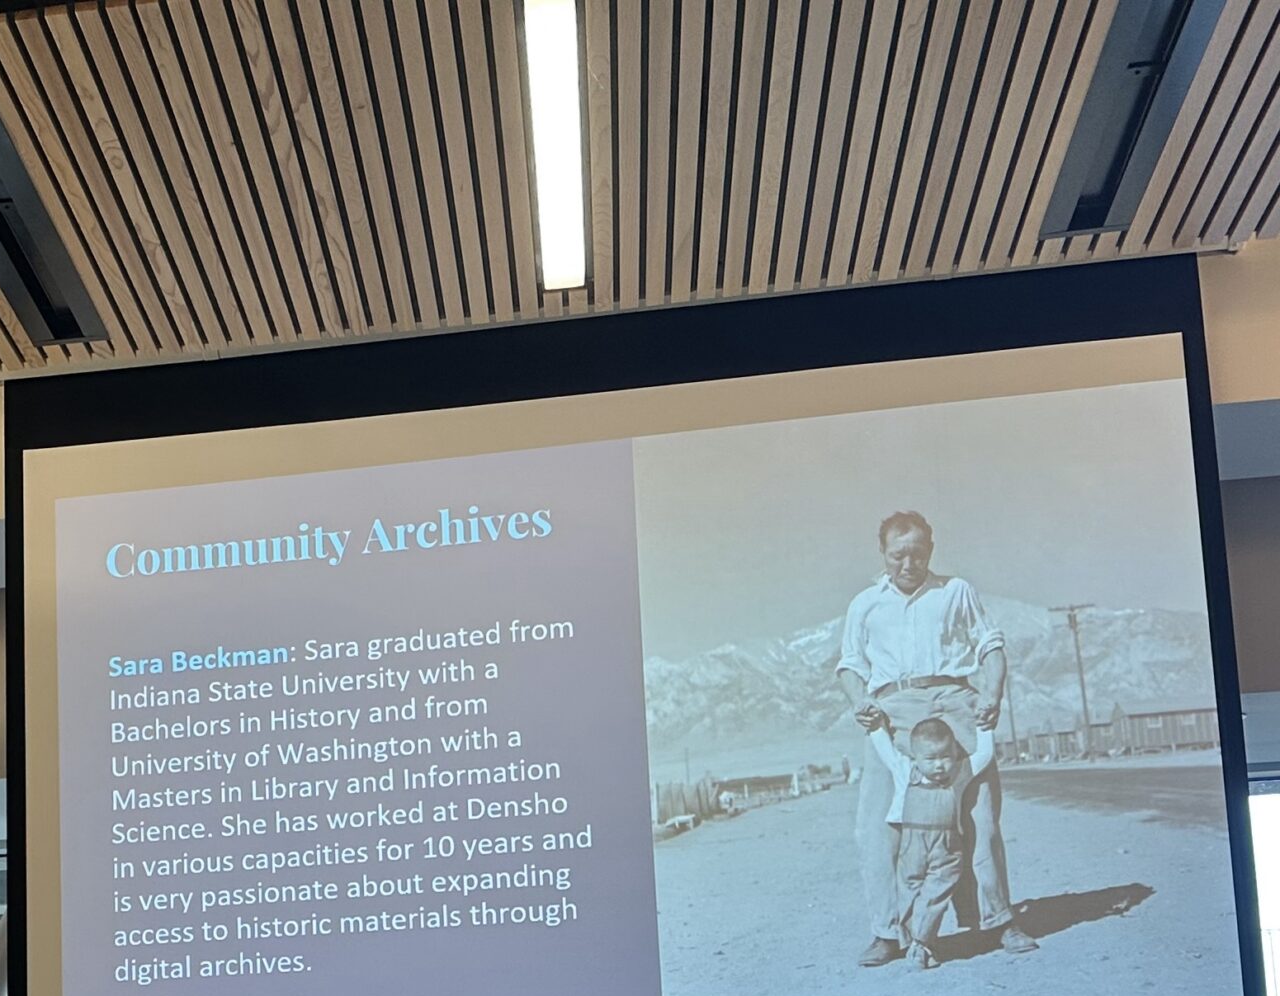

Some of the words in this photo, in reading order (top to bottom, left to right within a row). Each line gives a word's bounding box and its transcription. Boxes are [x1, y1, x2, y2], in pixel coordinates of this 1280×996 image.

[106, 523, 352, 578] Community
[361, 505, 553, 555] Archives
[108, 656, 163, 677] Sara
[171, 645, 297, 673] Beckman:
[304, 639, 359, 661] Sara
[367, 621, 501, 661] graduated
[508, 619, 574, 643] from
[110, 685, 201, 711] Indiana
[208, 679, 274, 703] State
[281, 666, 411, 697] University
[417, 658, 475, 685] with
[484, 662, 499, 680] a
[111, 715, 232, 743] Bachelors
[239, 711, 261, 734] in
[270, 707, 361, 732] History
[368, 696, 417, 723] and
[423, 695, 488, 719] from
[111, 750, 237, 777] University
[244, 743, 271, 768] of
[276, 736, 432, 765] Washington
[439, 725, 499, 753] with
[507, 730, 522, 748] a
[112, 787, 213, 811] Masters
[220, 785, 242, 804] in
[251, 776, 339, 801] Library
[346, 767, 394, 795] and
[403, 758, 561, 791] Information
[111, 820, 213, 845] Science.
[221, 813, 267, 837] She
[275, 809, 319, 834] has
[325, 799, 424, 830] worked
[432, 801, 459, 823] at
[467, 791, 568, 820] Densho
[113, 856, 135, 879] in
[141, 851, 235, 877] various
[241, 841, 369, 874] capacities
[375, 837, 415, 862] for
[423, 835, 455, 859] 10
[461, 834, 534, 861] years
[542, 823, 593, 851] and
[113, 890, 133, 913] is
[138, 891, 194, 914] very
[201, 880, 339, 913] passionate
[346, 873, 425, 899] about
[431, 863, 572, 897] expanding
[114, 926, 195, 947] access
[201, 921, 229, 942] to
[236, 915, 333, 940] historic
[339, 903, 462, 934] materials
[468, 896, 578, 927] through
[114, 954, 191, 986] digital
[199, 951, 312, 977] archives.
